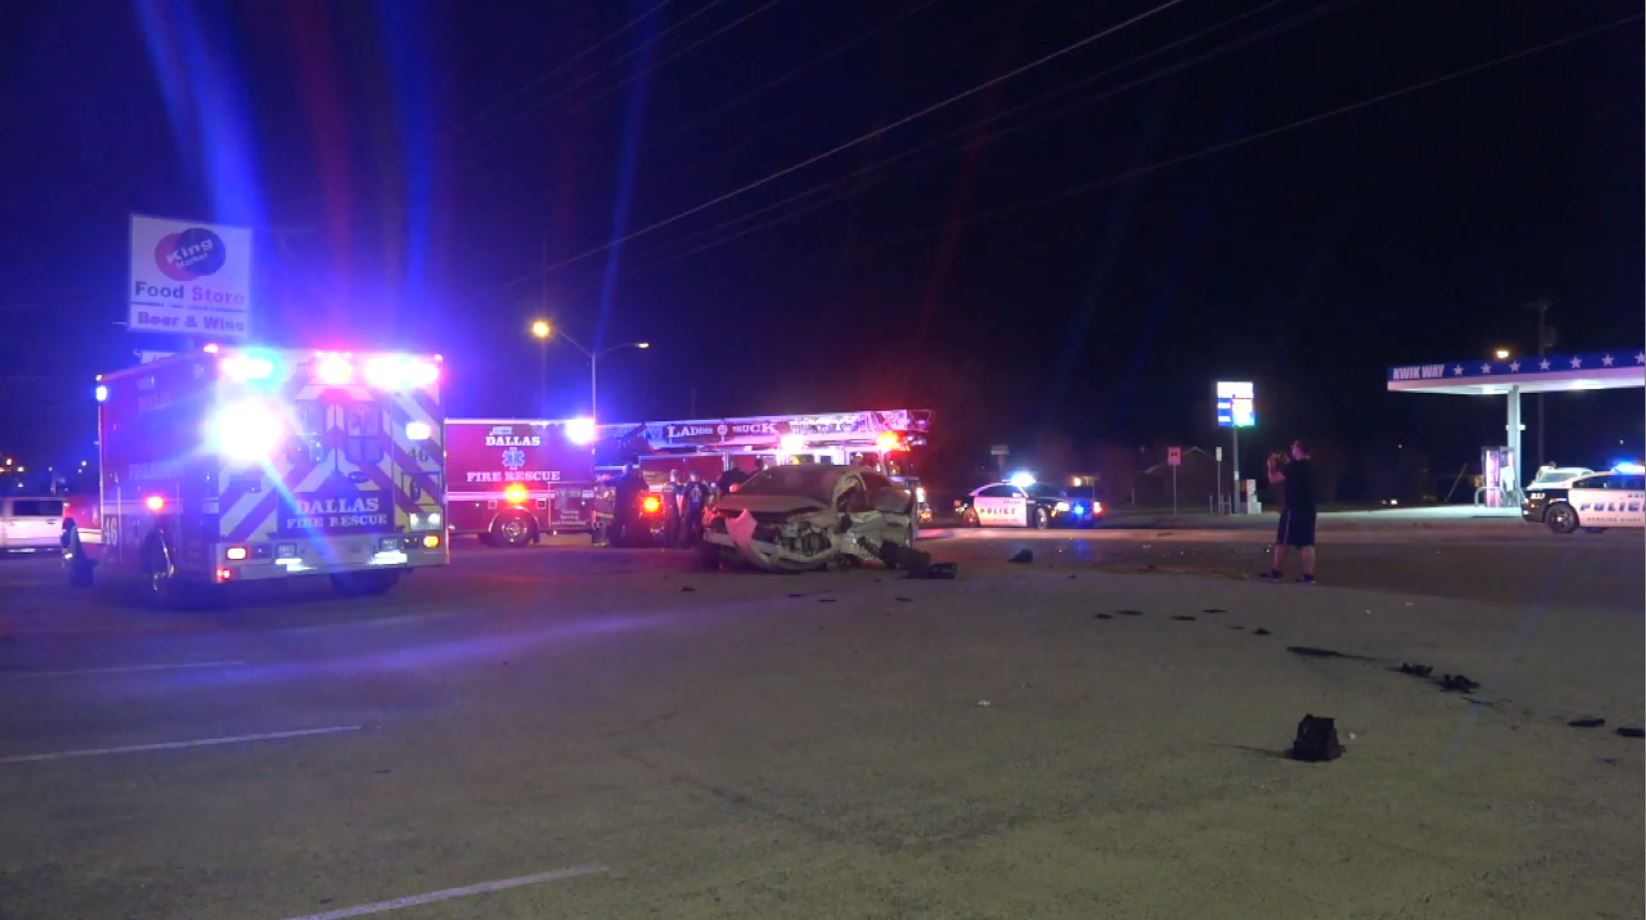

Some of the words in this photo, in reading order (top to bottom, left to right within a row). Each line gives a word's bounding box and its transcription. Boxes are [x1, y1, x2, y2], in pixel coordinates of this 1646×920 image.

[166, 239, 213, 264] King
[135, 281, 184, 299] Food
[192, 286, 245, 305] Store
[138, 311, 180, 327] Beer
[185, 315, 198, 328] &
[203, 316, 245, 332] Wine
[1393, 366, 1420, 379] KWIK
[1422, 364, 1444, 378] WAY
[485, 436, 540, 446] DALLAS
[467, 472, 501, 482] FIRE
[505, 471, 560, 481] RESCUE
[298, 498, 379, 514] DALLAS
[1580, 502, 1645, 512] POLIC
[287, 517, 324, 529] FIRE
[330, 514, 388, 527] RESCUE
[104, 517, 117, 546] 46
